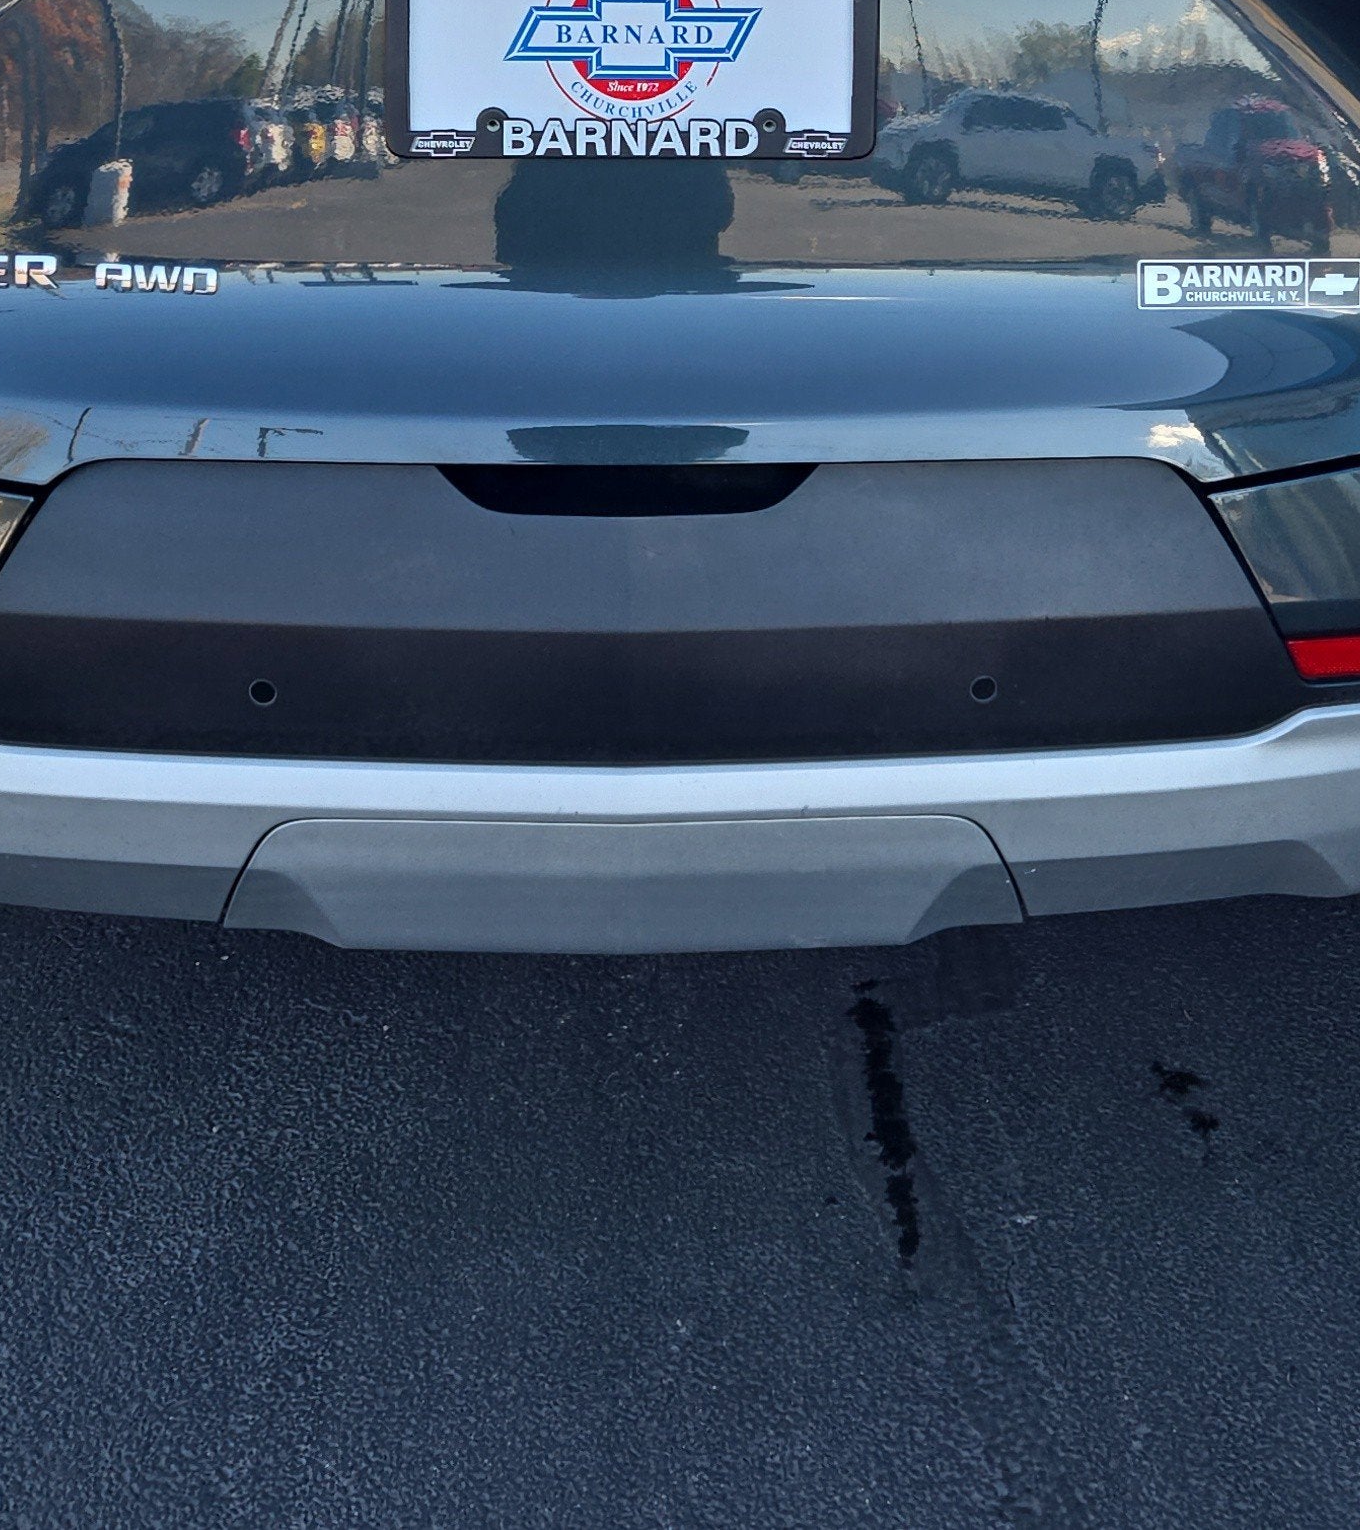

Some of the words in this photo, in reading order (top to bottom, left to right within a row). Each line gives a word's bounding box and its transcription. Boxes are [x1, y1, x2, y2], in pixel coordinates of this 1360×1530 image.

[555, 23, 714, 45] BARNARD
[606, 80, 634, 92] Since
[571, 80, 698, 118] CHURCHVILLE
[417, 140, 472, 149] CHEVROLET
[502, 120, 759, 157] BARNARD
[791, 141, 844, 150] CHEVROLET
[94, 262, 218, 295] AWD
[1144, 265, 1304, 304] BARNARD
[1185, 291, 1274, 304] CHURCHVILLE,
